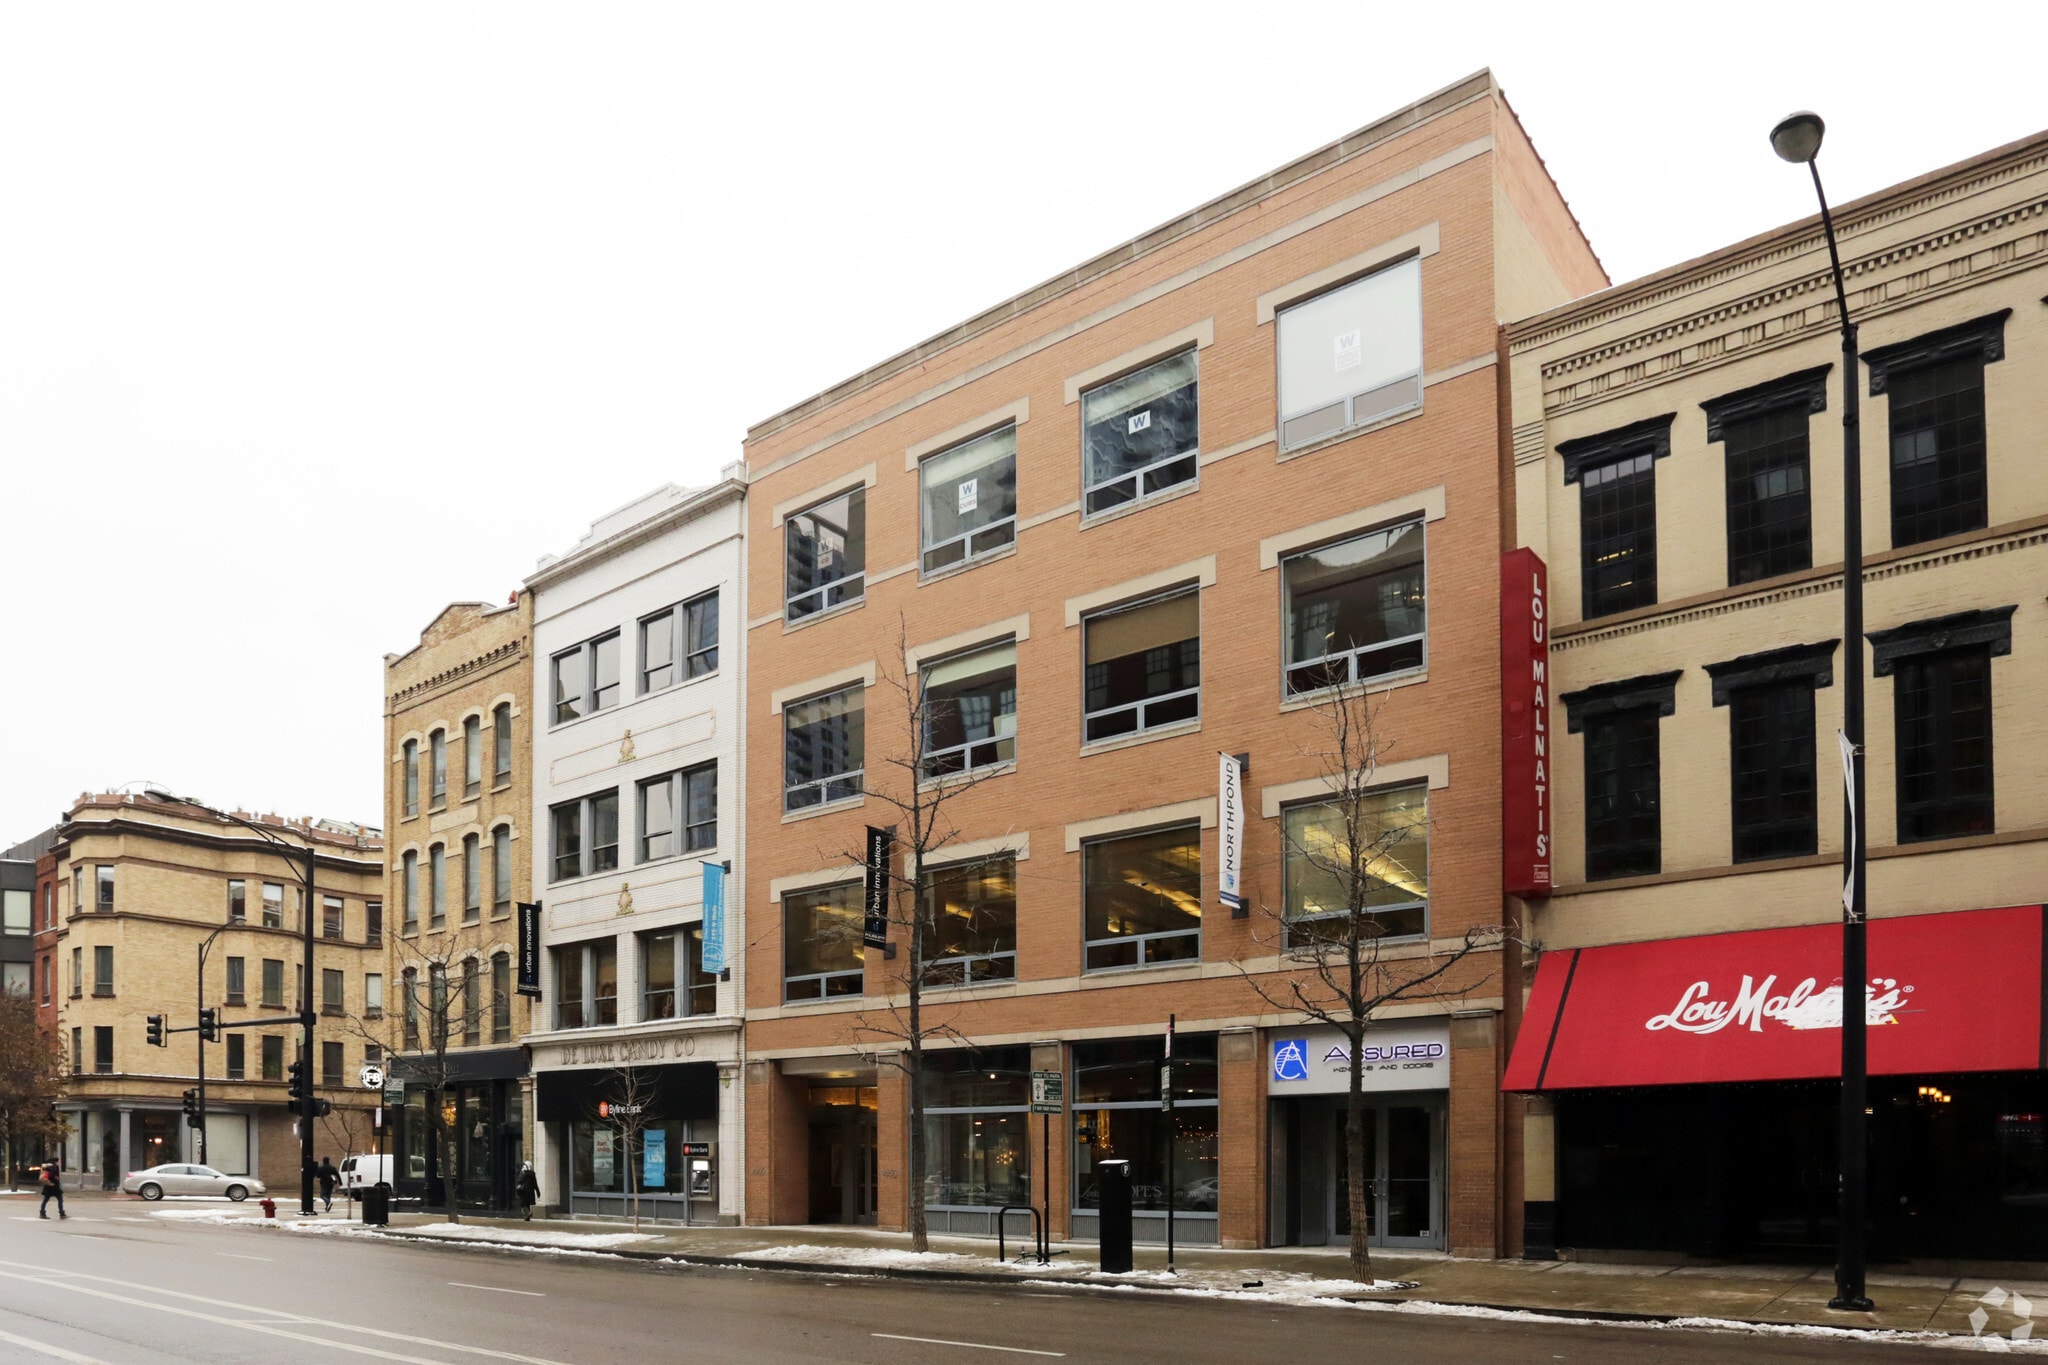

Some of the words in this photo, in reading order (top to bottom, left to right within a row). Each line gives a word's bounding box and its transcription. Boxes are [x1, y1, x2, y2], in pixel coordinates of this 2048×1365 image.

[1133, 414, 1146, 429] W
[962, 482, 974, 495] W
[1532, 573, 1544, 643] LOU
[1226, 762, 1235, 871] NORTHPOND
[1645, 981, 1727, 1033] Lou
[561, 1046, 578, 1065] DE
[582, 1043, 614, 1063] LUXE
[619, 1038, 667, 1062] CANDY
[673, 1036, 695, 1057] CO
